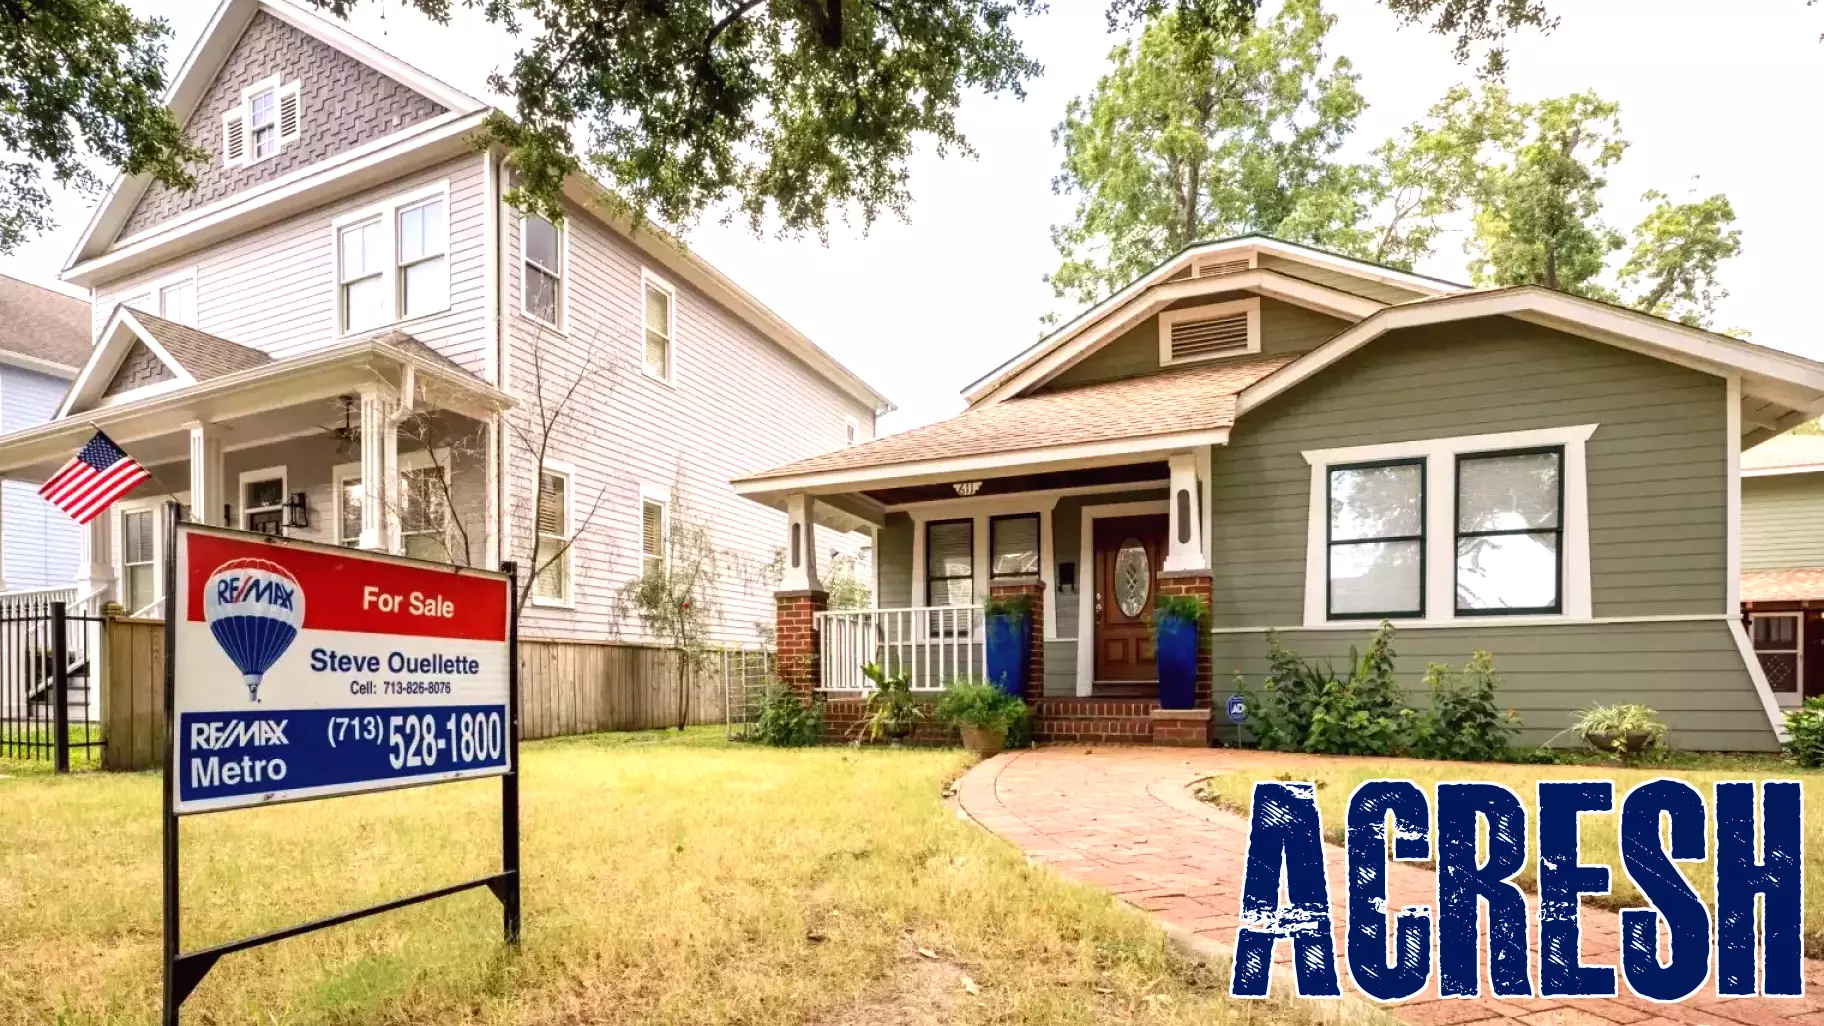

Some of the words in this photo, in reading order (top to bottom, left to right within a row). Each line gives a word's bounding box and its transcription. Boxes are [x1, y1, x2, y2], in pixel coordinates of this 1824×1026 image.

[217, 575, 294, 612] RE/MAX
[363, 586, 402, 613] For
[409, 591, 454, 618] Sale
[310, 648, 380, 672] Steve
[388, 651, 479, 674] Ouellette
[350, 680, 377, 695] Cell:
[383, 681, 451, 695] 713-826-8076
[190, 719, 289, 750] RE/MAX
[327, 716, 384, 747] (713)
[389, 711, 500, 769] 528-1800
[190, 757, 287, 788] Metro
